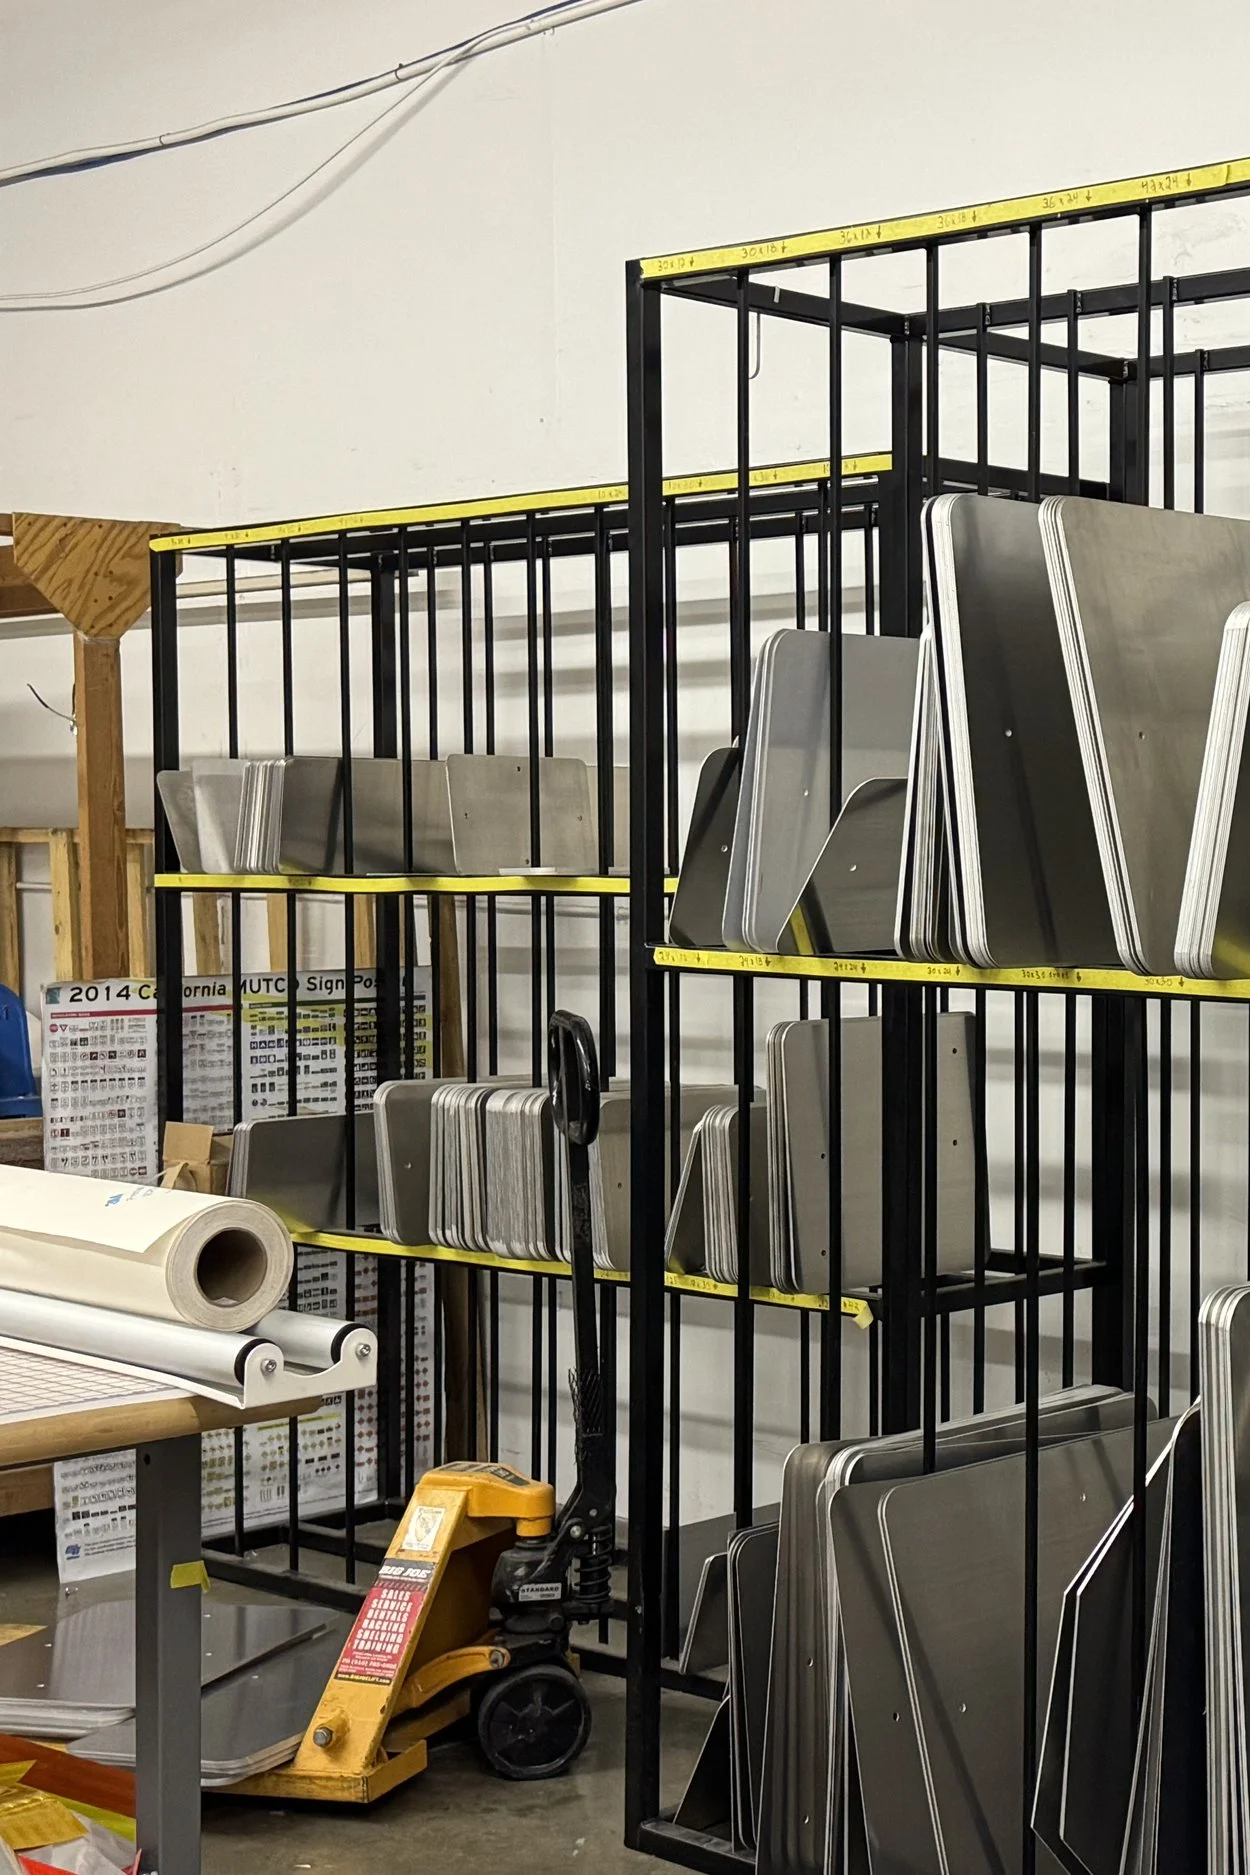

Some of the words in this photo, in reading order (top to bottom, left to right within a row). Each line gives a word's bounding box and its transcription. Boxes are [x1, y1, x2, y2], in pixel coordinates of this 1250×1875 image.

[69, 985, 131, 1003] 2014
[138, 981, 227, 1001] Caornia
[306, 976, 345, 995] Sign
[378, 1565, 405, 1576] BIG
[402, 1567, 432, 1578] JOE
[380, 1588, 412, 1602] SALES
[371, 1598, 413, 1612] SERVICE
[366, 1608, 410, 1623] RENTALS
[361, 1618, 406, 1633] RACKING
[356, 1628, 404, 1643] SHELVING
[352, 1639, 400, 1654] TRAINING
